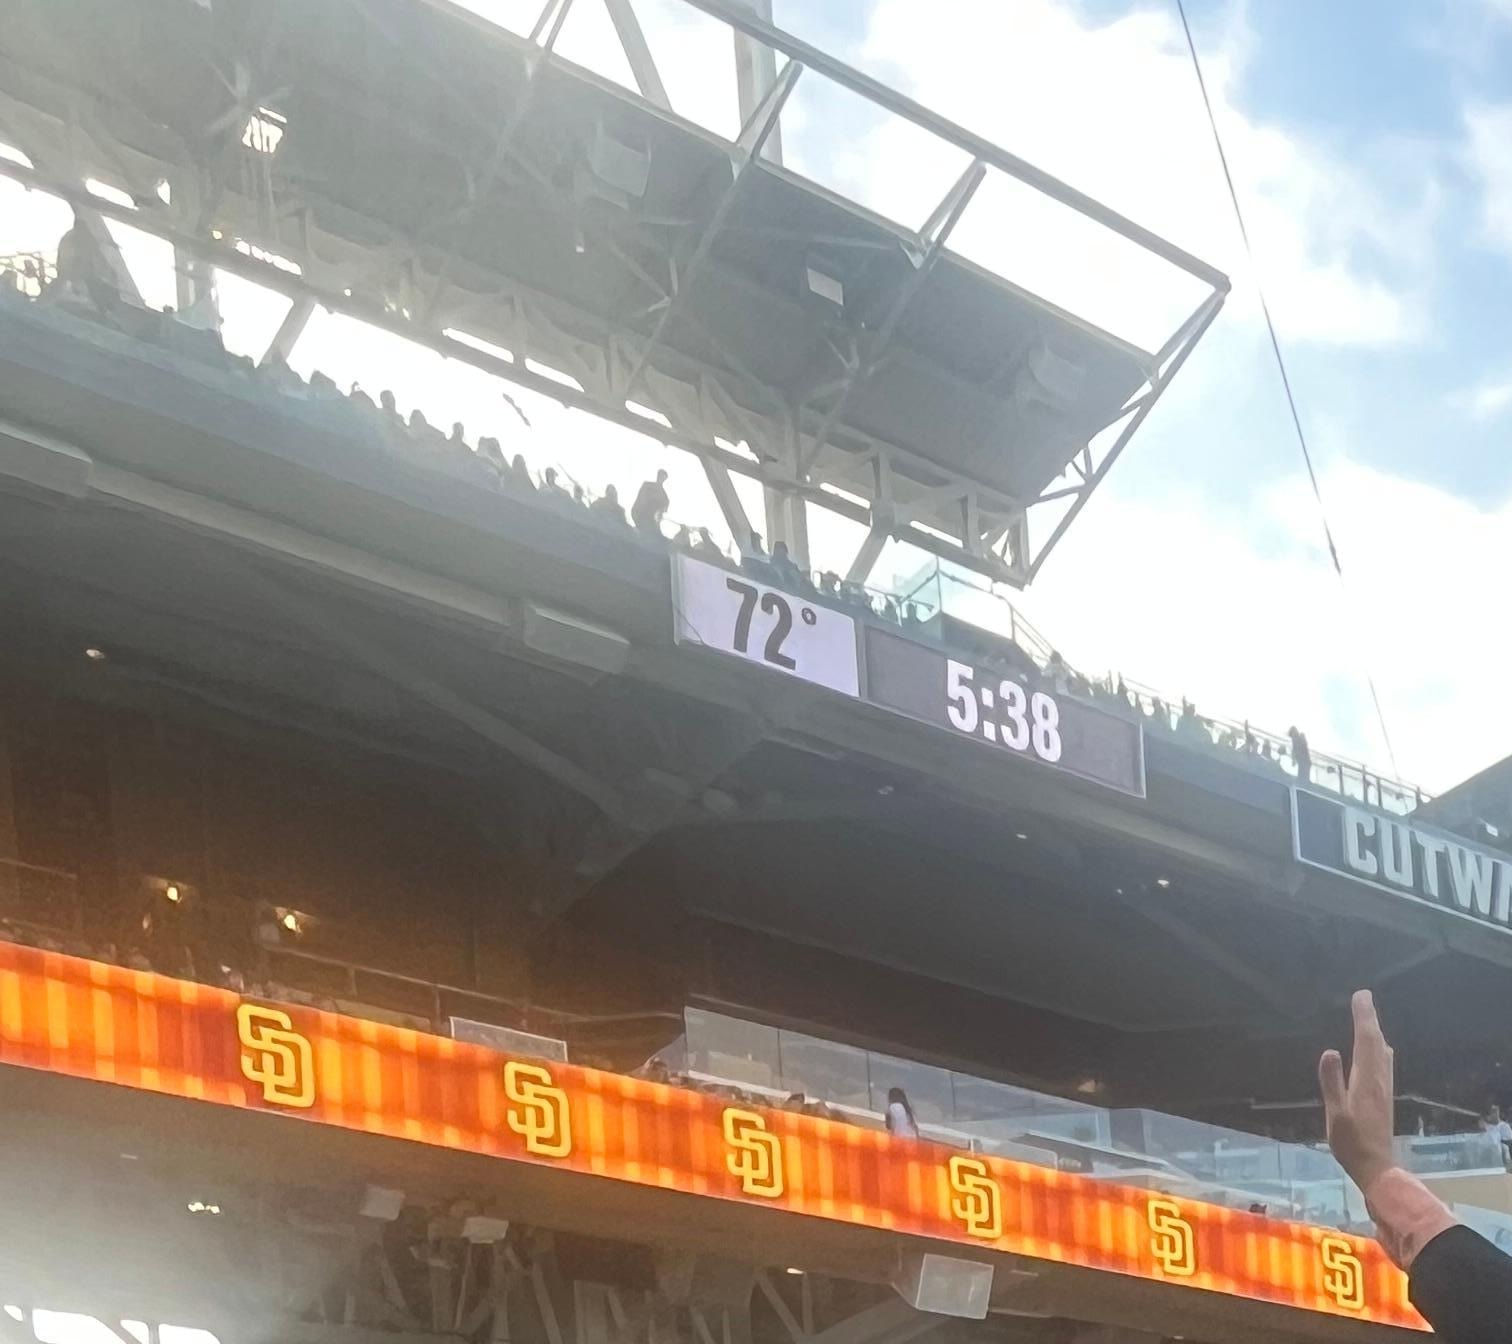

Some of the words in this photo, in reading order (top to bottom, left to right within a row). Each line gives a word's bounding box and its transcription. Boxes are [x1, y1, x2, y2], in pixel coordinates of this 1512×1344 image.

[725, 576, 817, 671] 72°
[946, 658, 1063, 763] 5:38
[236, 1003, 316, 1108] SD
[503, 1060, 572, 1158] SD
[723, 1107, 784, 1198] SD
[948, 1155, 1003, 1241] SD
[1148, 1197, 1196, 1277] SD
[1321, 1236, 1365, 1311] SD
